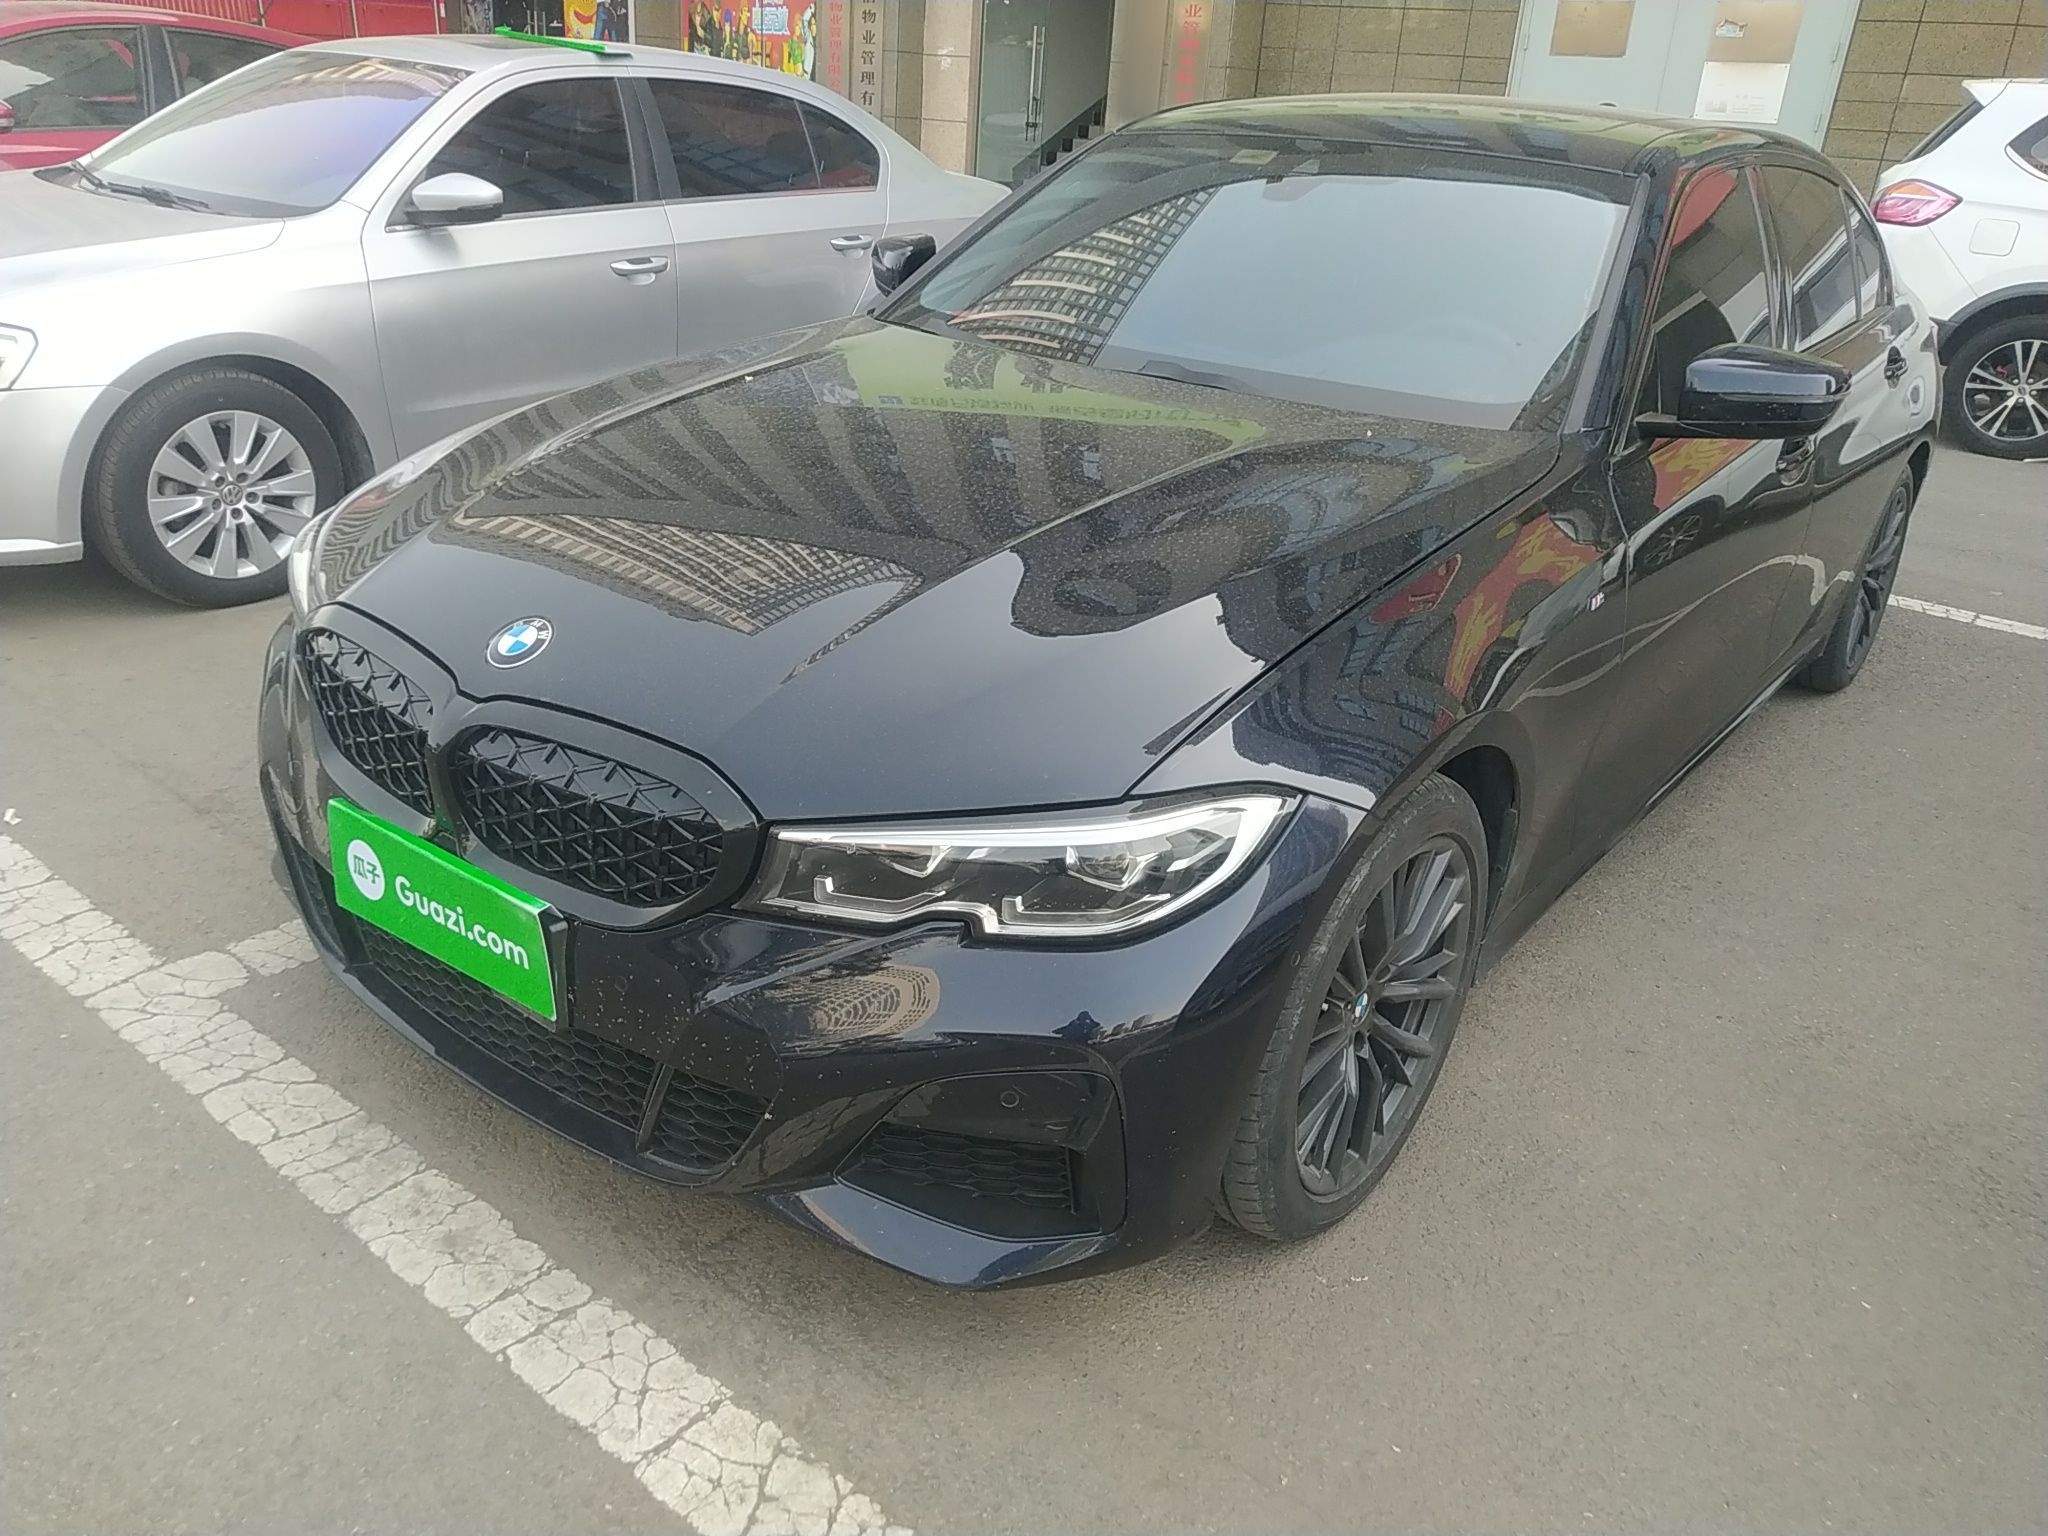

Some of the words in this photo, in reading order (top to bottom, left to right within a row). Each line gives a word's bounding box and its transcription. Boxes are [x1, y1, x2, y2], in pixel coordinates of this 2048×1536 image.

[859, 0, 877, 115] 物业管理有
[352, 853, 381, 885] 瓜子
[394, 874, 531, 971] Guazi.com
